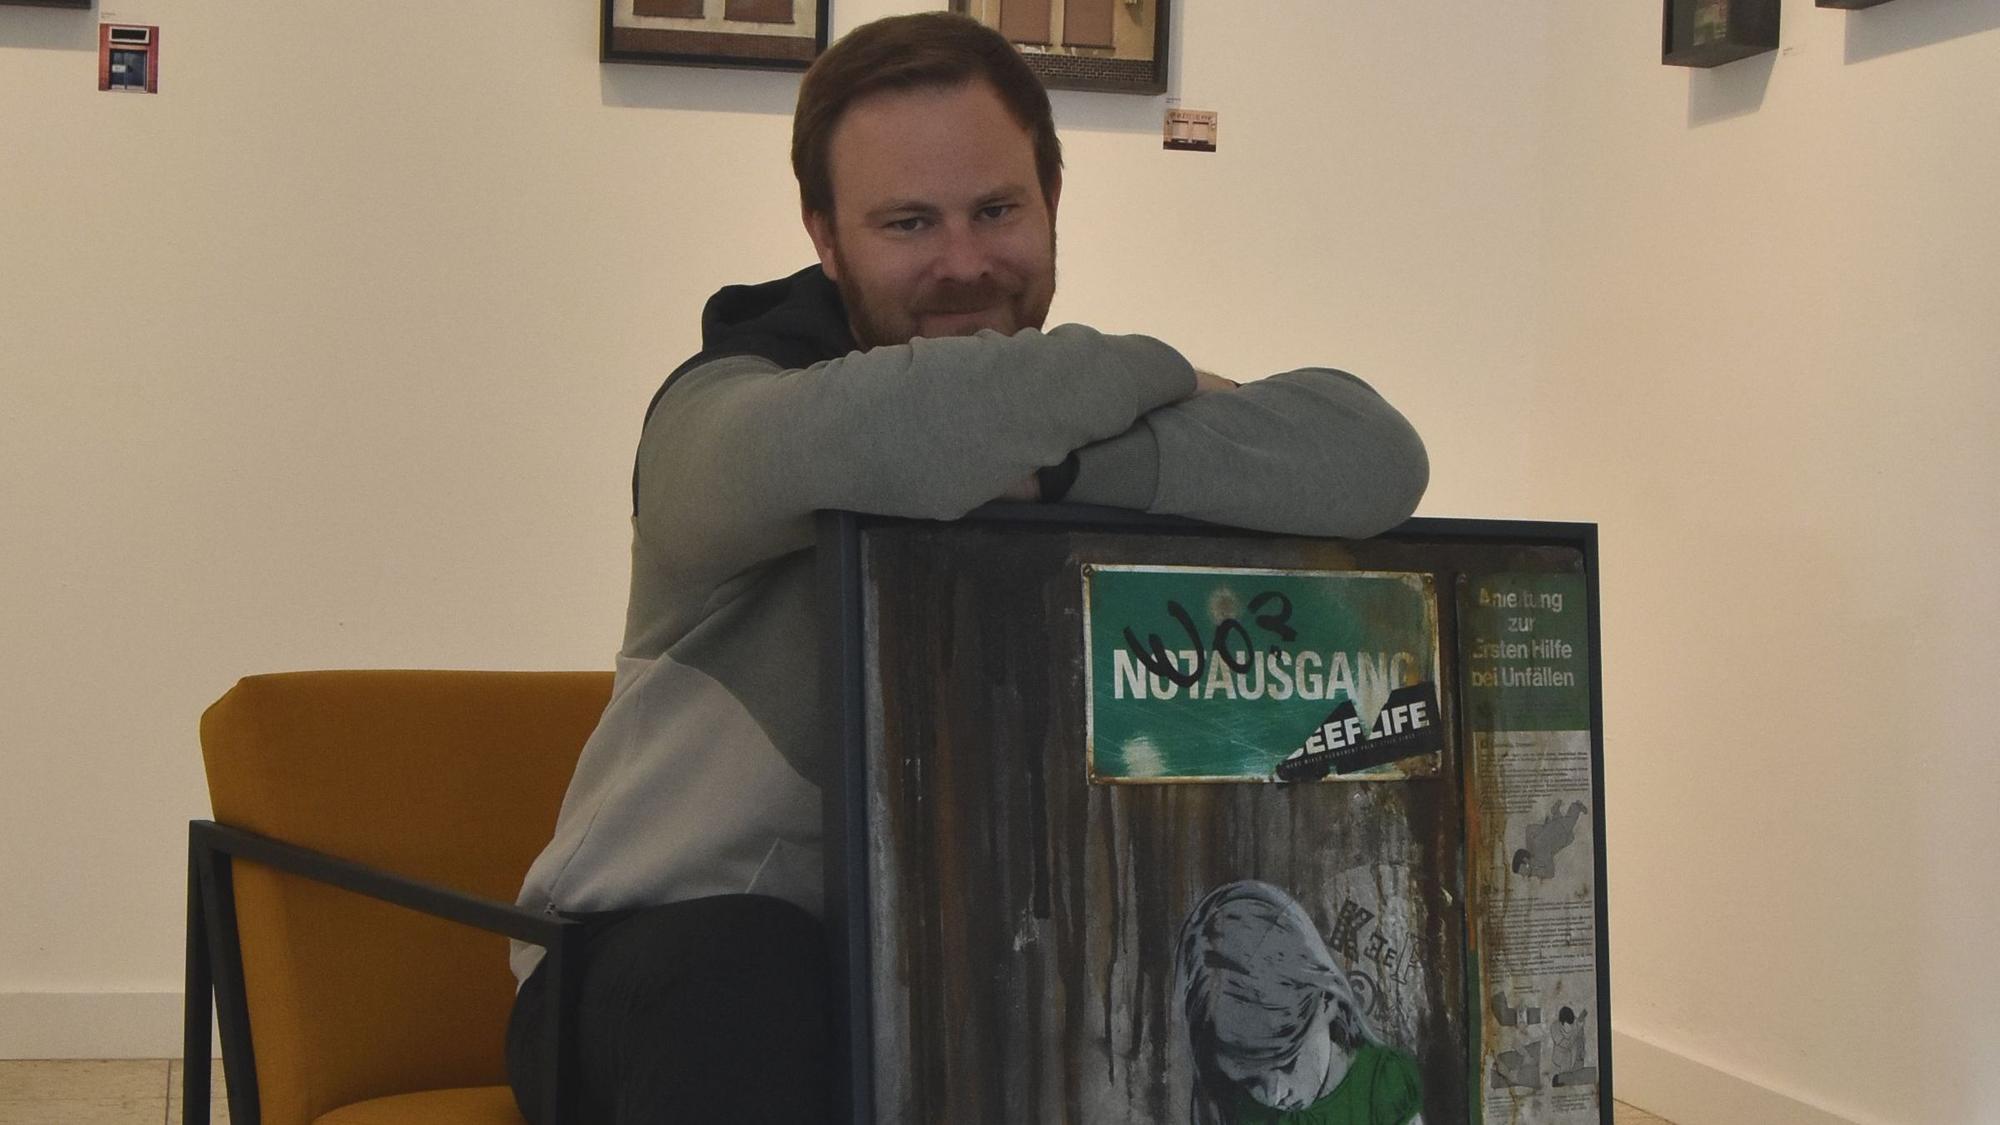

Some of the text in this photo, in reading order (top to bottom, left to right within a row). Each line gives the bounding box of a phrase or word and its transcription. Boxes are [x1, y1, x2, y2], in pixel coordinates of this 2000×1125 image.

[1508, 617, 1536, 632] zur
[1532, 639, 1573, 659] Hilfe
[1472, 666, 1575, 687] bei Unfällen
